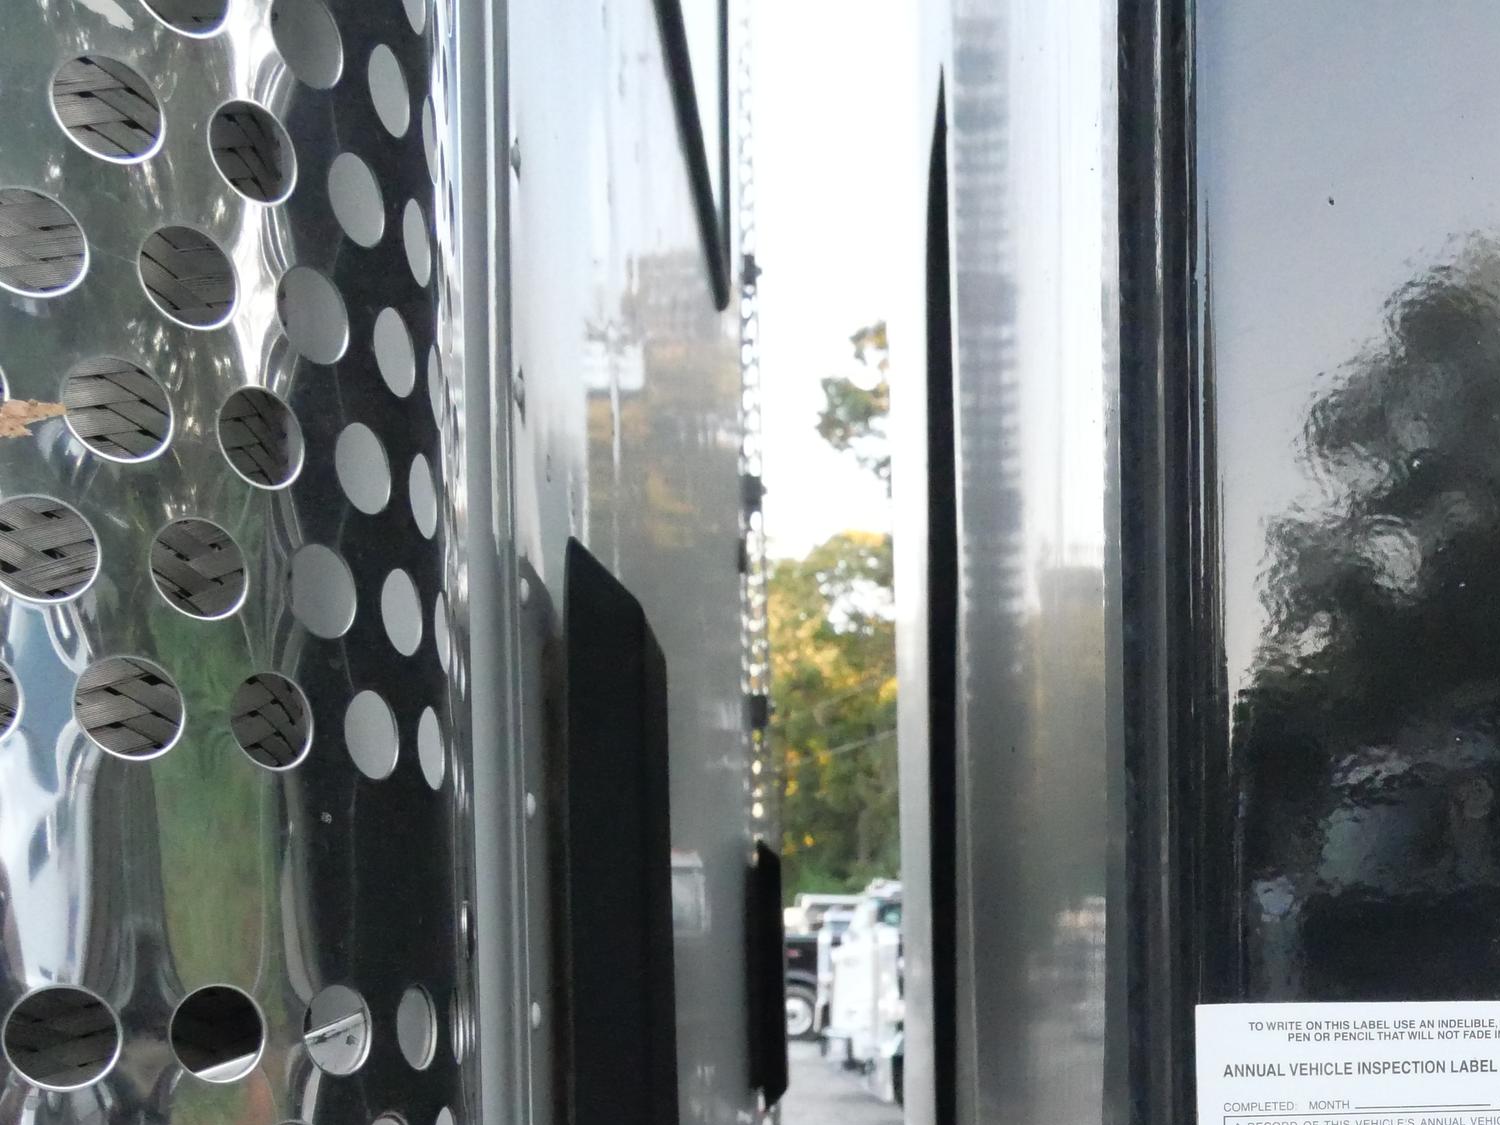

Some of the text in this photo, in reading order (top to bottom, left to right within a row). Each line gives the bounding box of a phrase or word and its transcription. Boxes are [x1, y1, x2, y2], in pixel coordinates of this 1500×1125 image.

[1248, 1021, 1264, 1031] TO
[1266, 1021, 1302, 1031] WRITE
[1305, 1021, 1322, 1031] ON
[1324, 1020, 1350, 1030] THIS
[1353, 1020, 1390, 1030] LABEL
[1393, 1019, 1416, 1029] USE
[1419, 1019, 1435, 1029] AN
[1438, 1018, 1498, 1029] INDELIBLE,
[1287, 1032, 1311, 1042] PEN
[1313, 1032, 1330, 1042] OR
[1334, 1031, 1375, 1041] PENCIL
[1376, 1031, 1406, 1041] THAT
[1407, 1031, 1434, 1040] WILL
[1437, 1030, 1460, 1040] NOT
[1463, 1029, 1491, 1039] FADE
[1223, 1059, 1498, 1077] ANNUAL VEHICLE INSPECTION LABEL
[1309, 1100, 1350, 1110] MONTH
